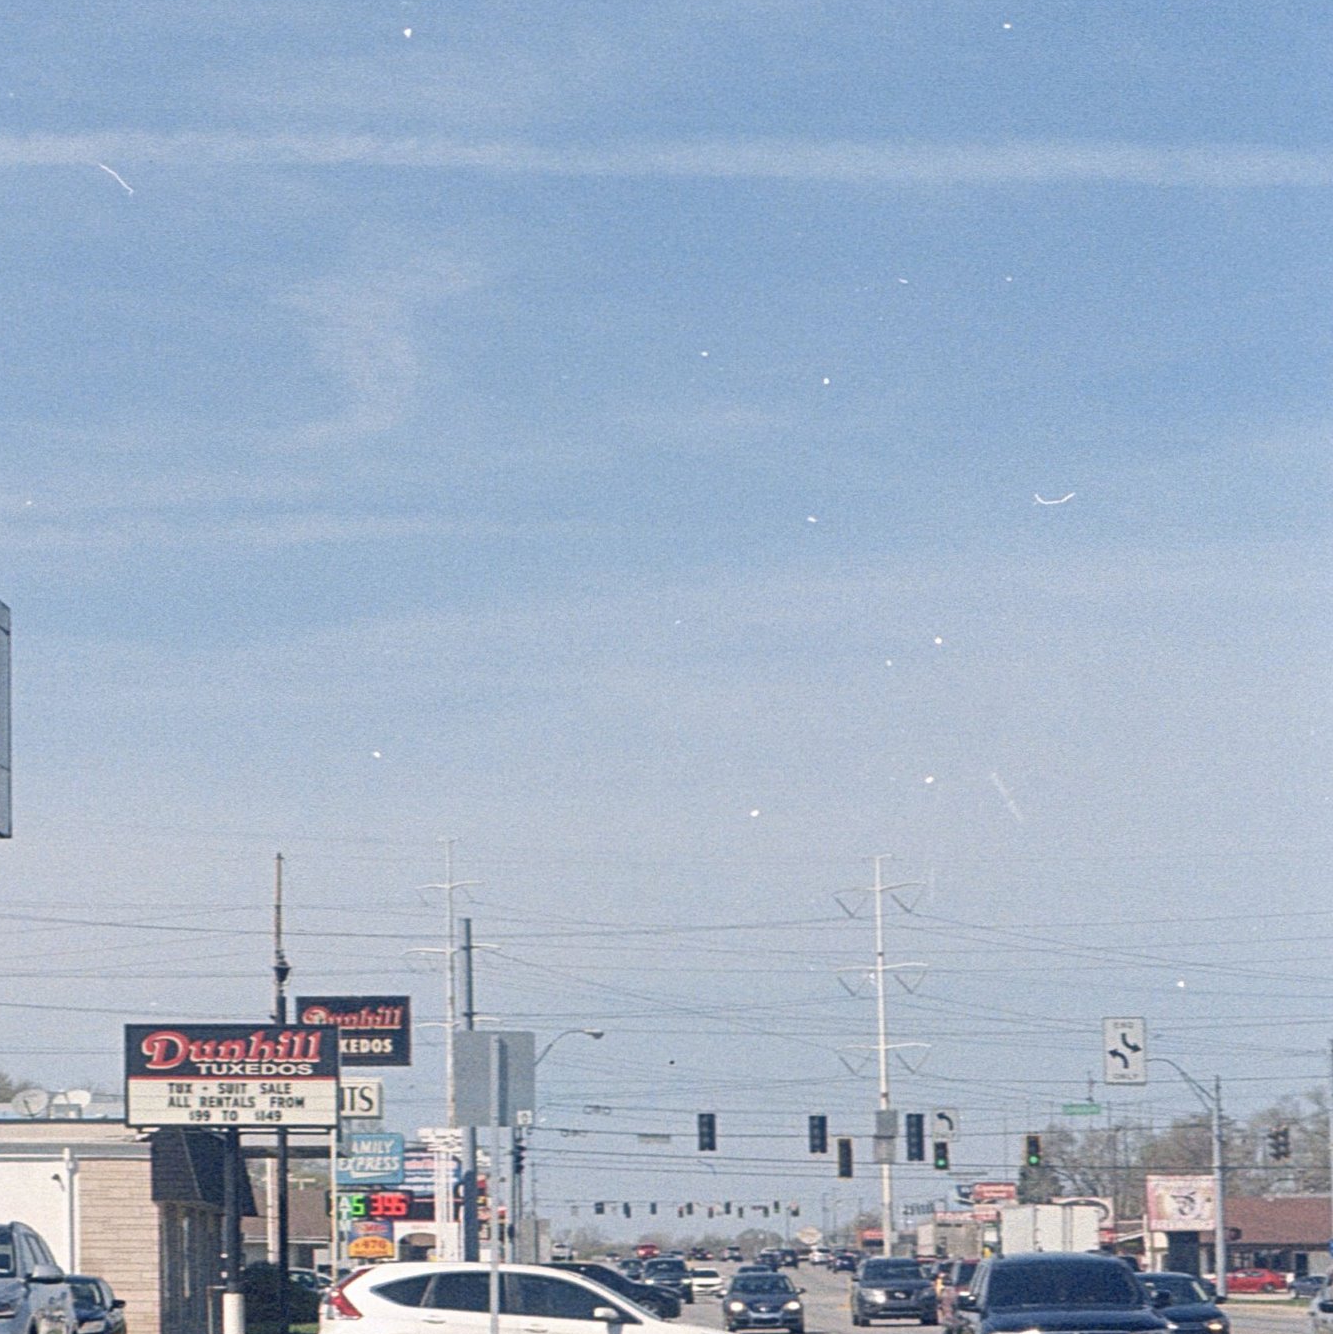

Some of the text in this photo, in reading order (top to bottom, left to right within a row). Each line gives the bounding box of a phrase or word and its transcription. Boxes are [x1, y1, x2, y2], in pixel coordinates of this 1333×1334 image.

[142, 1031, 321, 1069] Dunhill
[198, 1063, 313, 1075] TUXEDOS
[168, 1083, 193, 1094] TUX
[218, 1083, 247, 1094] SUIT
[260, 1083, 292, 1094] SALE
[168, 1096, 305, 1108] ALL RENTALS FROM
[189, 1110, 282, 1121] $99 TO $149
[352, 1140, 395, 1154] AMILY
[337, 1156, 399, 1171] EXPRESS
